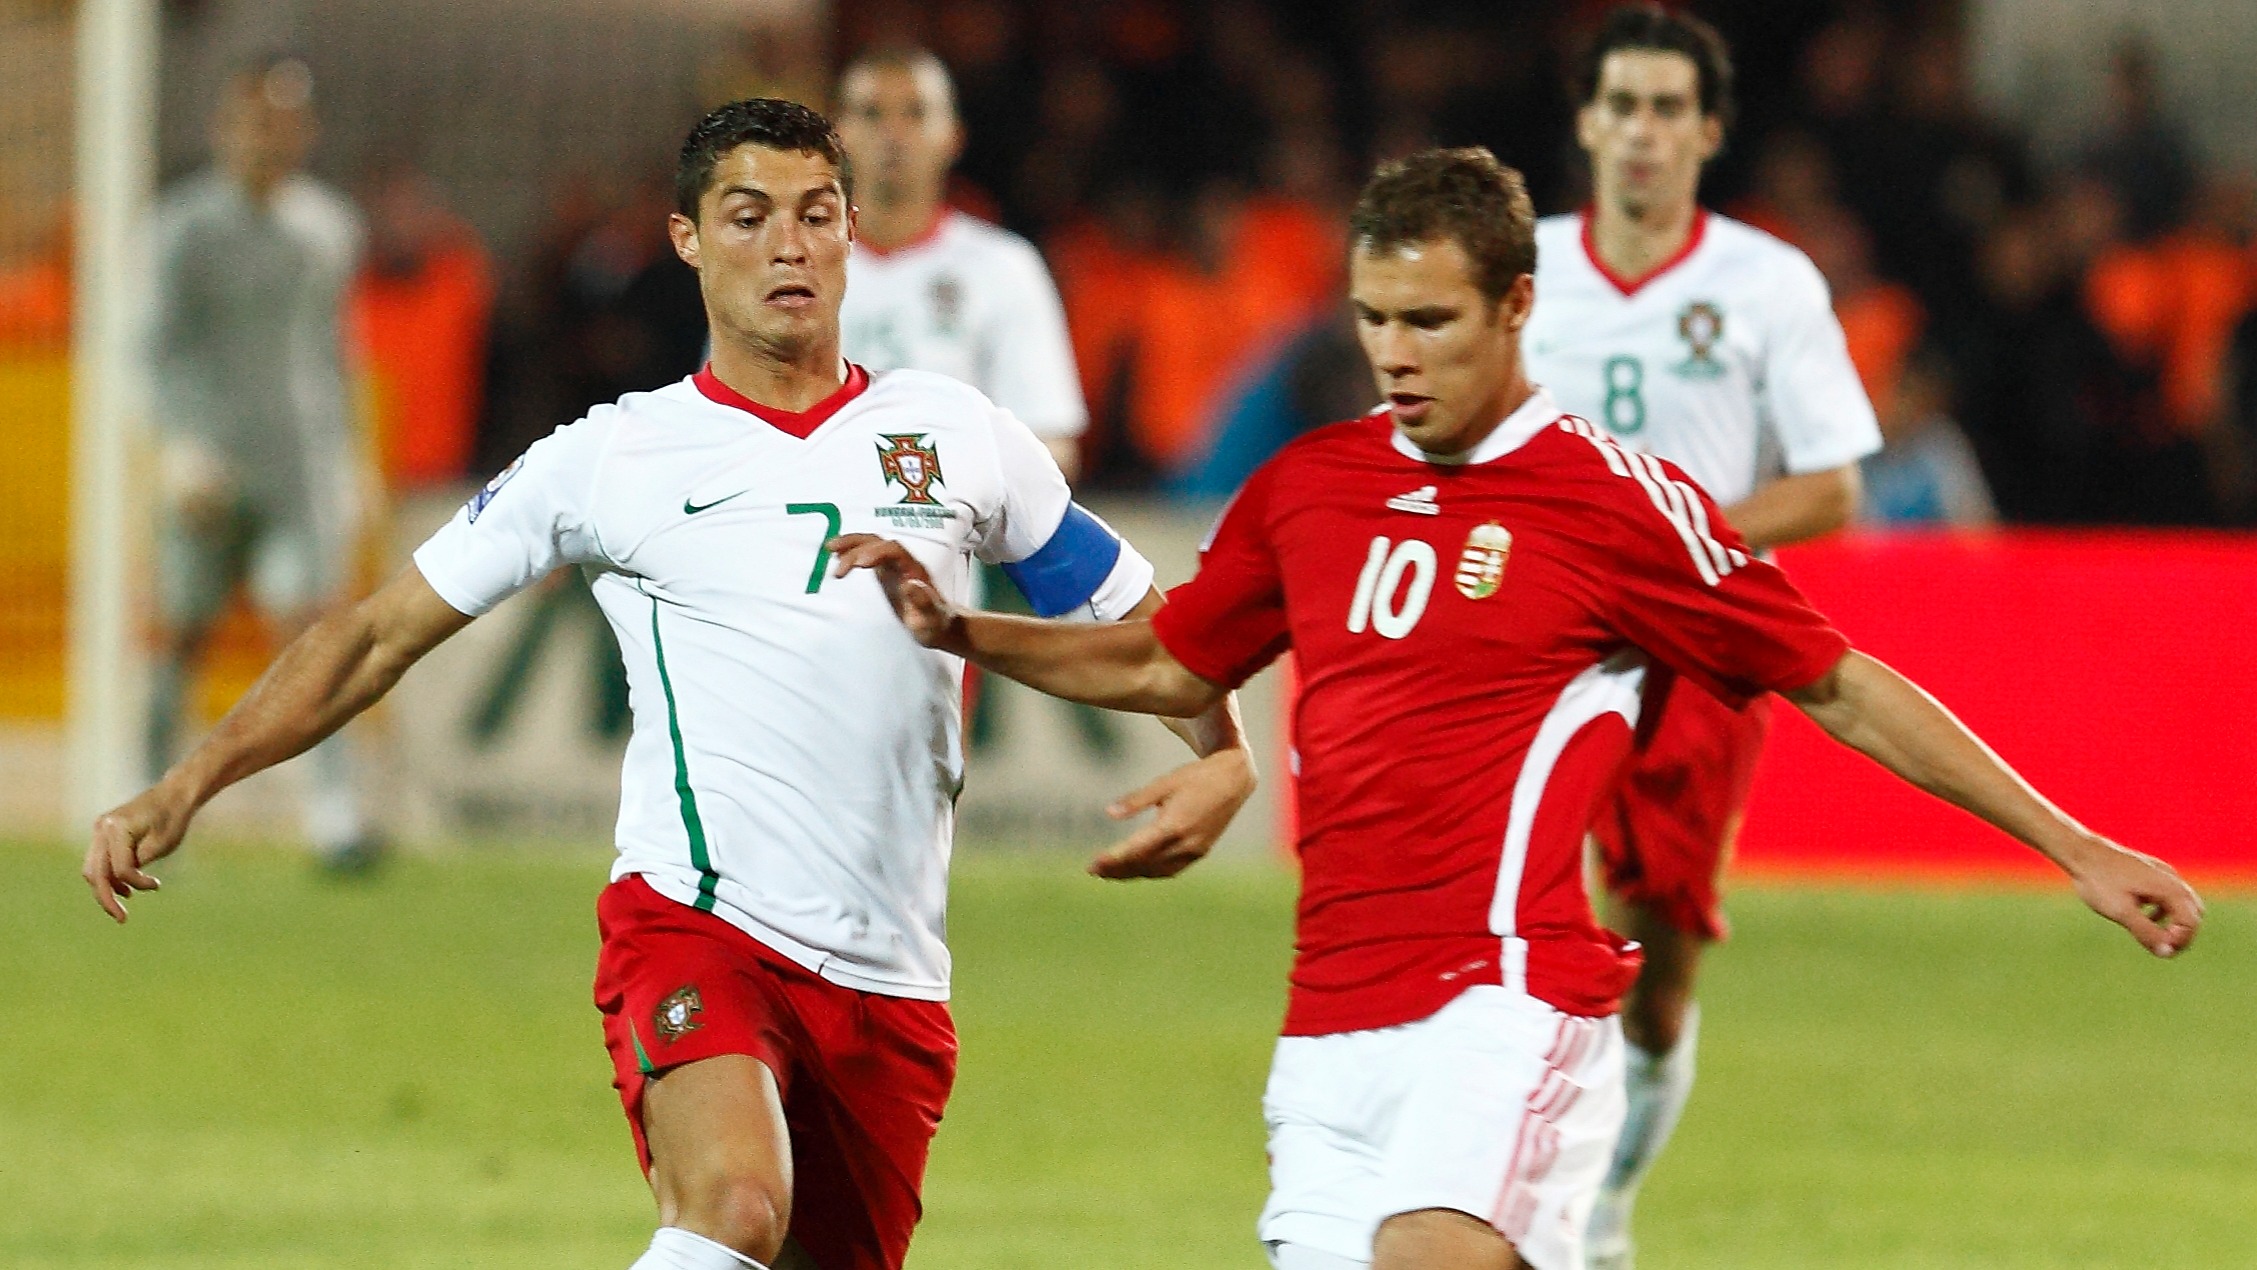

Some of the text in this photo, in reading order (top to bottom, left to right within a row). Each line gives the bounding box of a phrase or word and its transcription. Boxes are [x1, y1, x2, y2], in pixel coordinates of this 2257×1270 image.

[1605, 355, 1644, 433] 8
[785, 502, 840, 594] 7
[1347, 535, 1438, 640] 10
